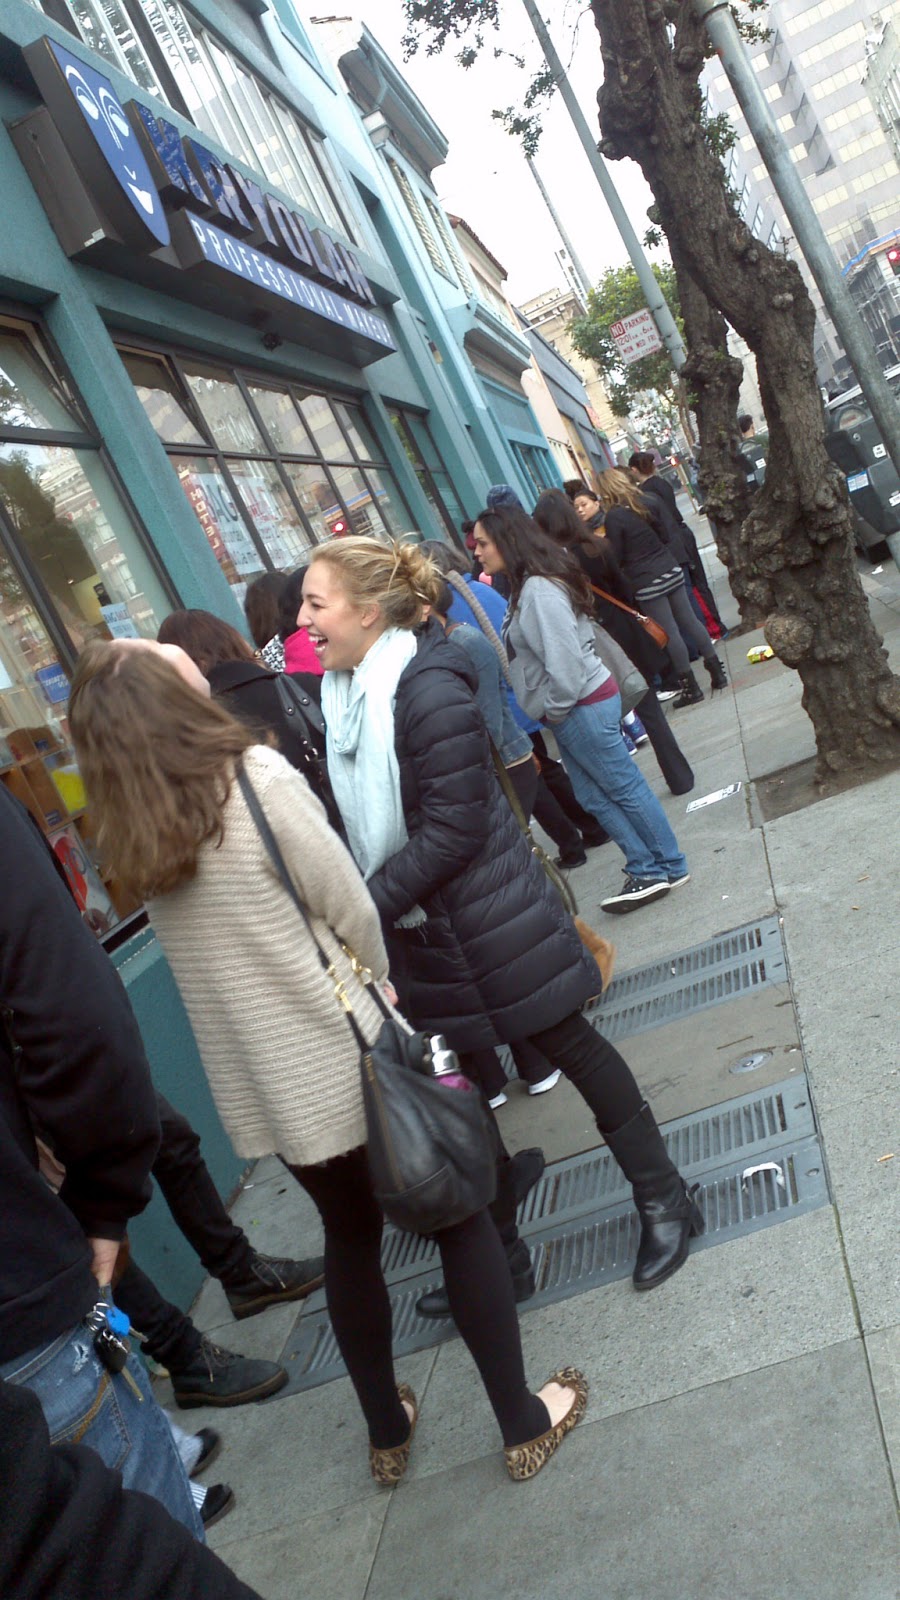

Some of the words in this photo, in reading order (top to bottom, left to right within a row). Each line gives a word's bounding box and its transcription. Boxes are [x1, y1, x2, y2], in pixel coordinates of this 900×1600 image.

[131, 99, 377, 307] KRYOLAN
[190, 218, 344, 322] PROFESSIONAL
[342, 302, 394, 346] MAKEUP
[610, 322, 624, 338] NO
[624, 312, 650, 331] PARKING
[623, 345, 634, 354] MON
[635, 339, 646, 348] WED
[647, 334, 657, 343] FRI
